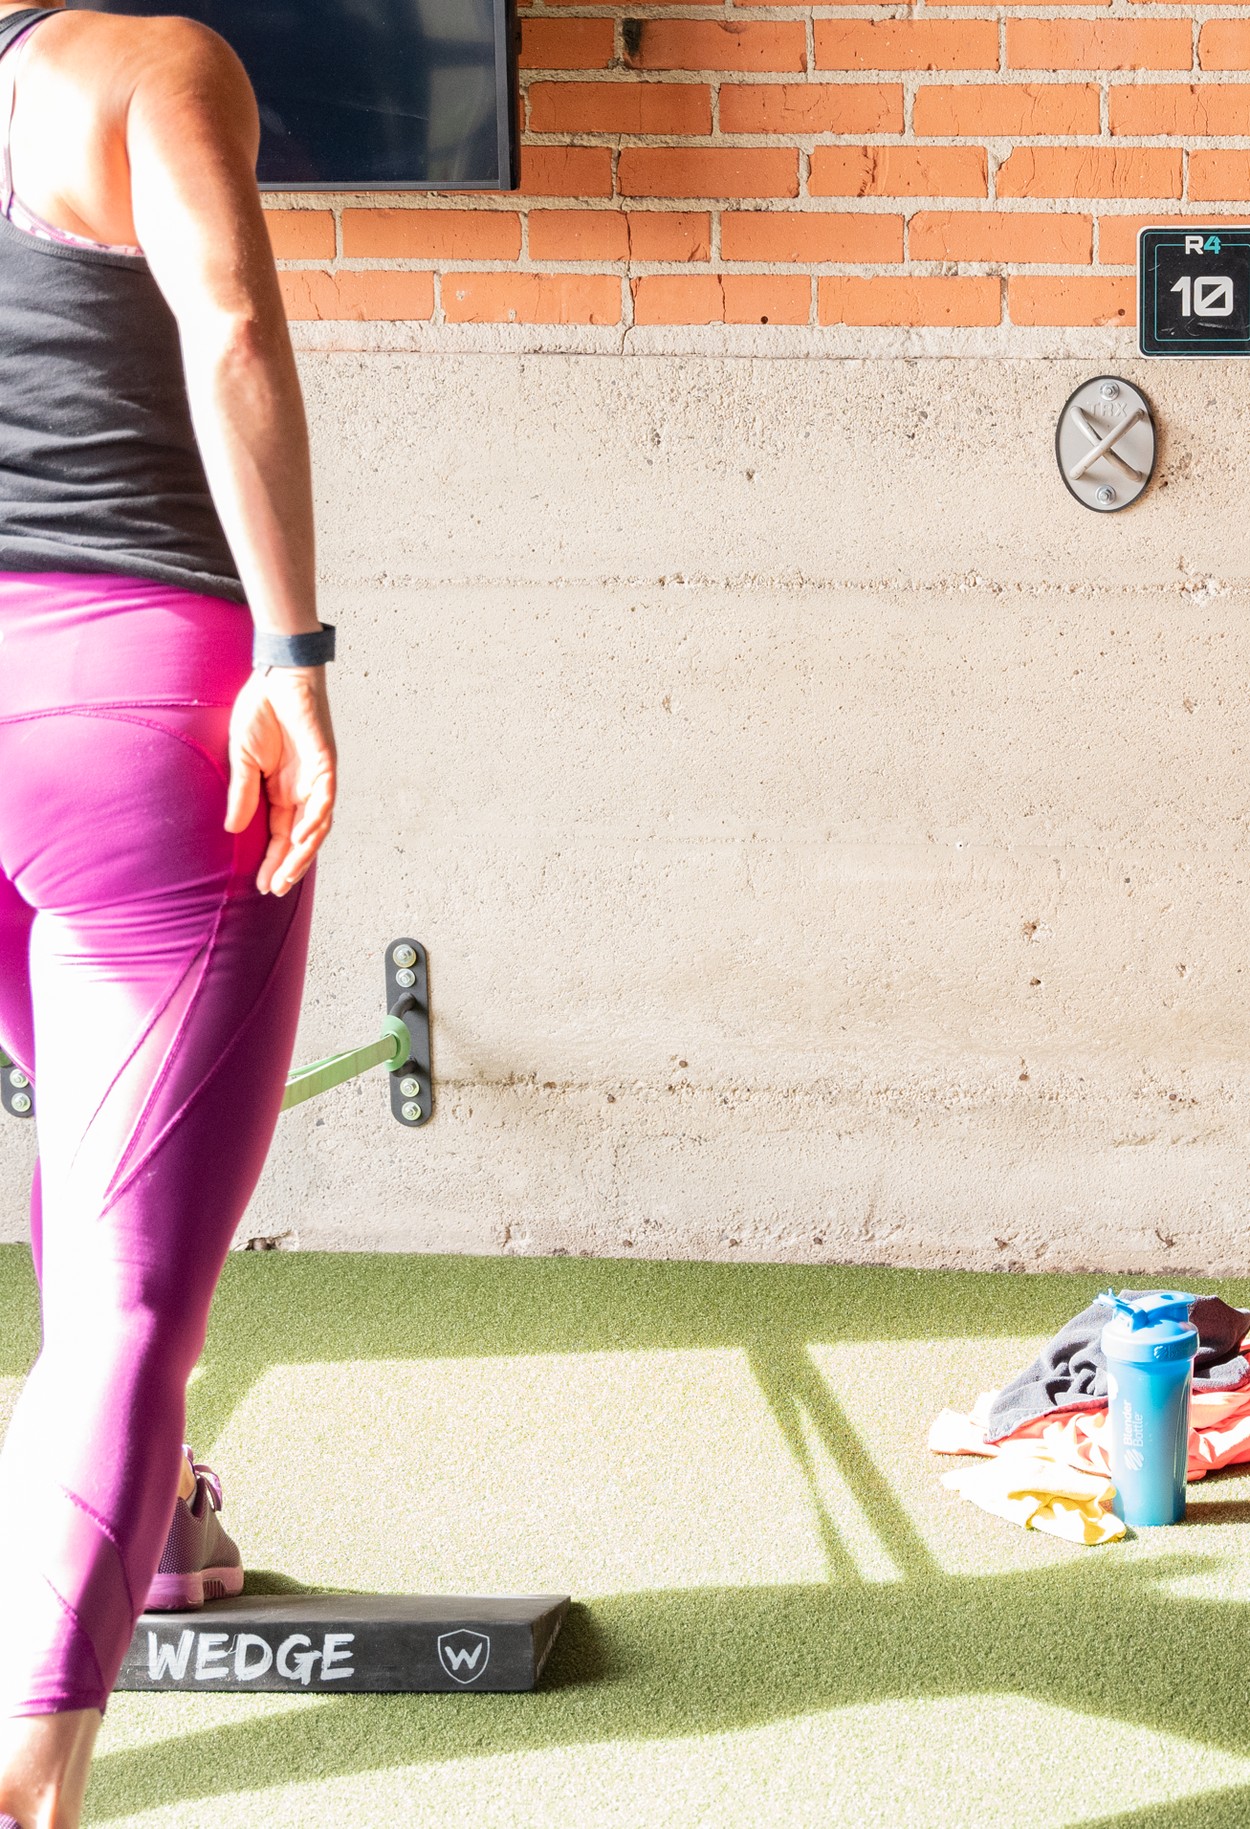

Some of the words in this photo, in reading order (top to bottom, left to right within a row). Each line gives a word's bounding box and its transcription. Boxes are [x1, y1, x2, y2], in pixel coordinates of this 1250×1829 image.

[1184, 235, 1222, 255] R4
[1169, 275, 1234, 317] 10
[1086, 401, 1128, 417] TRX
[1122, 1399, 1133, 1446] Blender
[1132, 1413, 1144, 1447] Bottle
[147, 1629, 356, 1686] WEDGE
[444, 1641, 483, 1671] W
